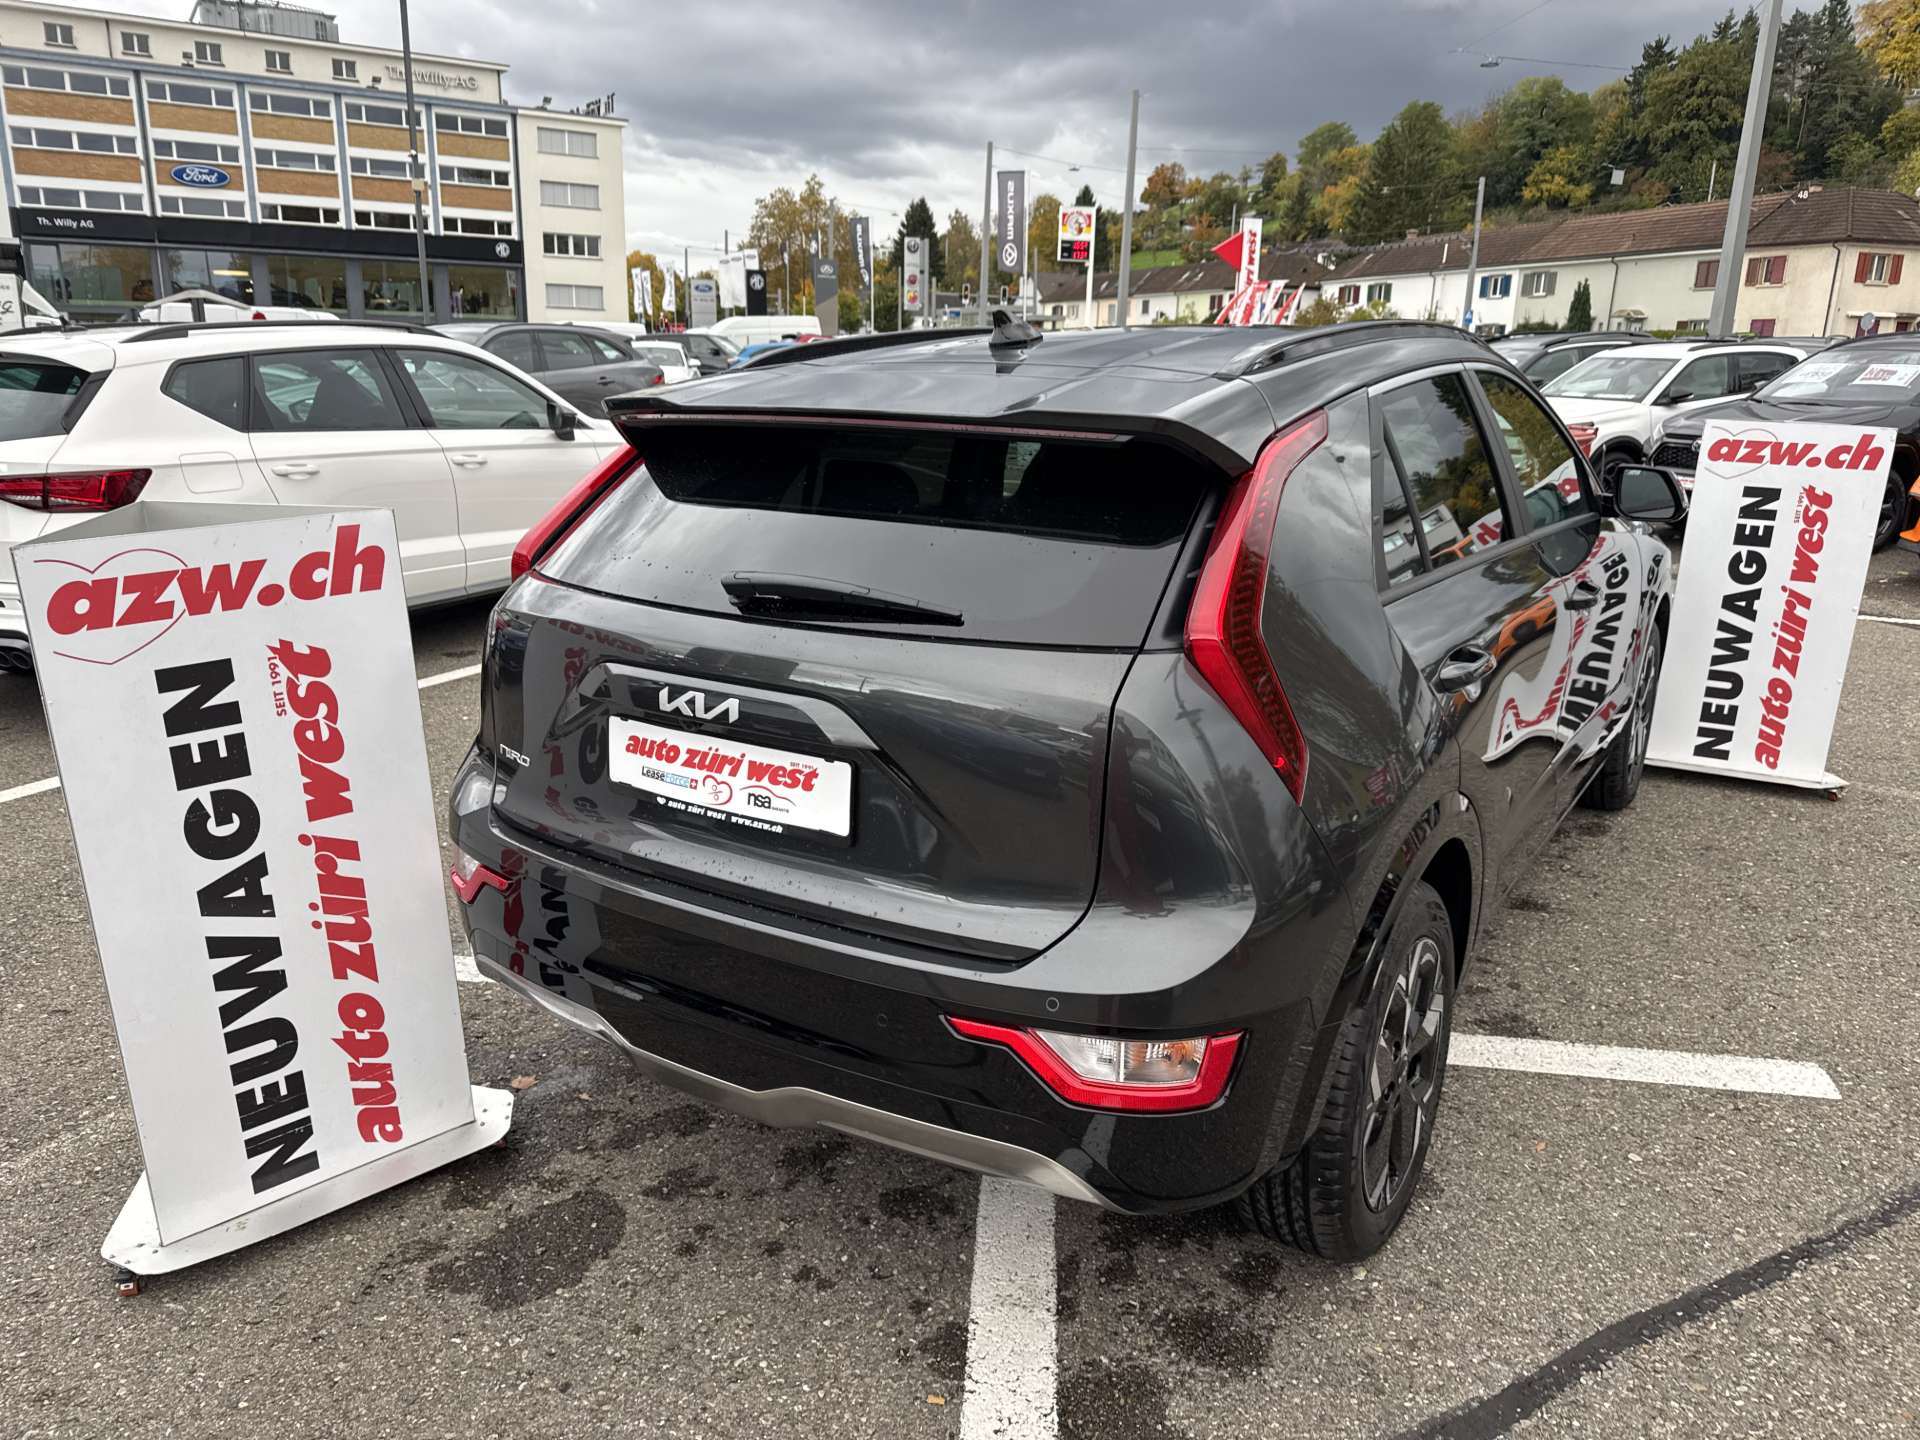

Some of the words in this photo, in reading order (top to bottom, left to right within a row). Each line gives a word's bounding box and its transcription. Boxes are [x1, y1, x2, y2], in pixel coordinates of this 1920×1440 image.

[413, 69, 453, 89] Willy
[456, 75, 479, 90] AG
[1797, 190, 1809, 199] 48
[36, 216, 52, 227] Th.
[54, 217, 78, 229] Willy
[79, 219, 95, 229] AG
[1707, 434, 1885, 471] azw.ch
[1790, 484, 1834, 583] west
[1793, 509, 1801, 524] SEIT
[47, 523, 385, 635] azw.ch
[1693, 485, 1782, 761] NEUWAGEN
[1771, 586, 1811, 680] züri
[266, 654, 284, 687] 1991
[273, 690, 287, 717] SEIT
[658, 686, 740, 724] KIA
[267, 639, 353, 823] west
[1754, 678, 1793, 770] auto
[499, 743, 531, 768] NIRO
[625, 734, 680, 765] auto
[680, 747, 747, 778] züri
[747, 760, 819, 793] west
[641, 765, 690, 788] LeaseForce
[668, 800, 686, 811] auto
[687, 804, 706, 815] züri
[706, 809, 727, 821] west
[731, 815, 784, 834] www.azw.ch
[746, 791, 771, 809] nsa
[155, 657, 320, 1195] NEUWAGEN
[298, 834, 380, 983] züri
[330, 990, 403, 1143] auto
